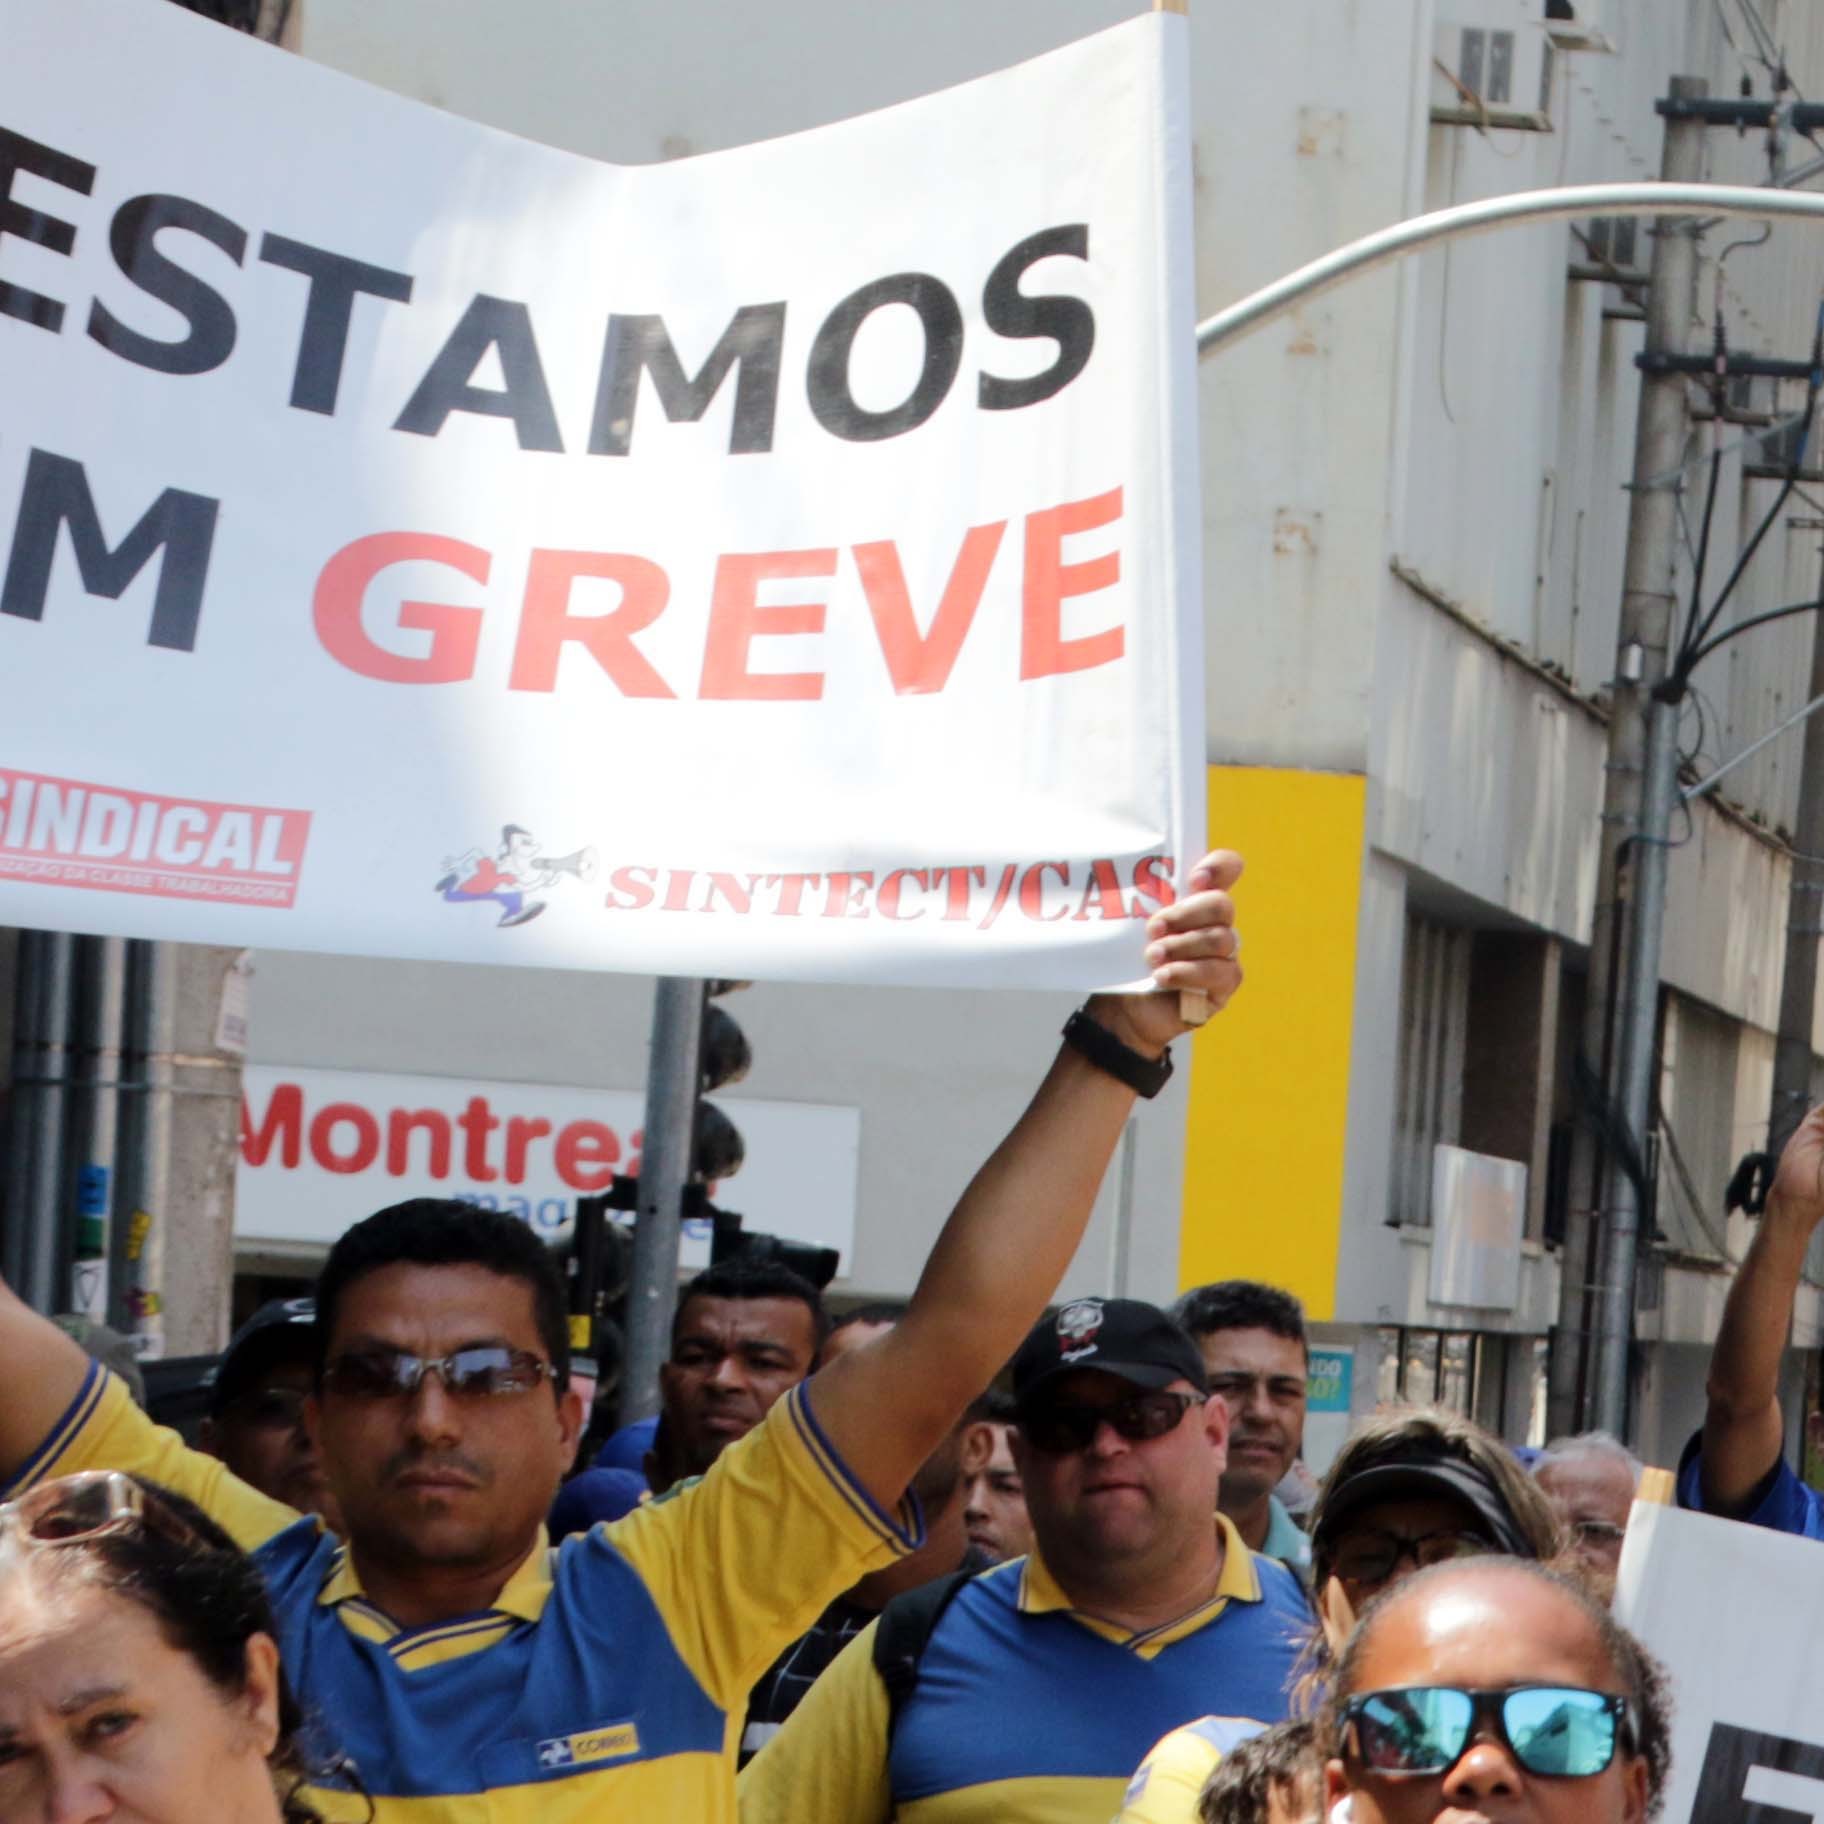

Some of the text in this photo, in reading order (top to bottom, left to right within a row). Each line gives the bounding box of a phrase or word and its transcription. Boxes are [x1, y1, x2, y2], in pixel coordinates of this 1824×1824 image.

[0, 126, 1096, 456] ESTAMOS
[313, 487, 1126, 702] GREVE
[604, 855, 1176, 930] SINTECT/CAS
[240, 1084, 650, 1192] Montre
